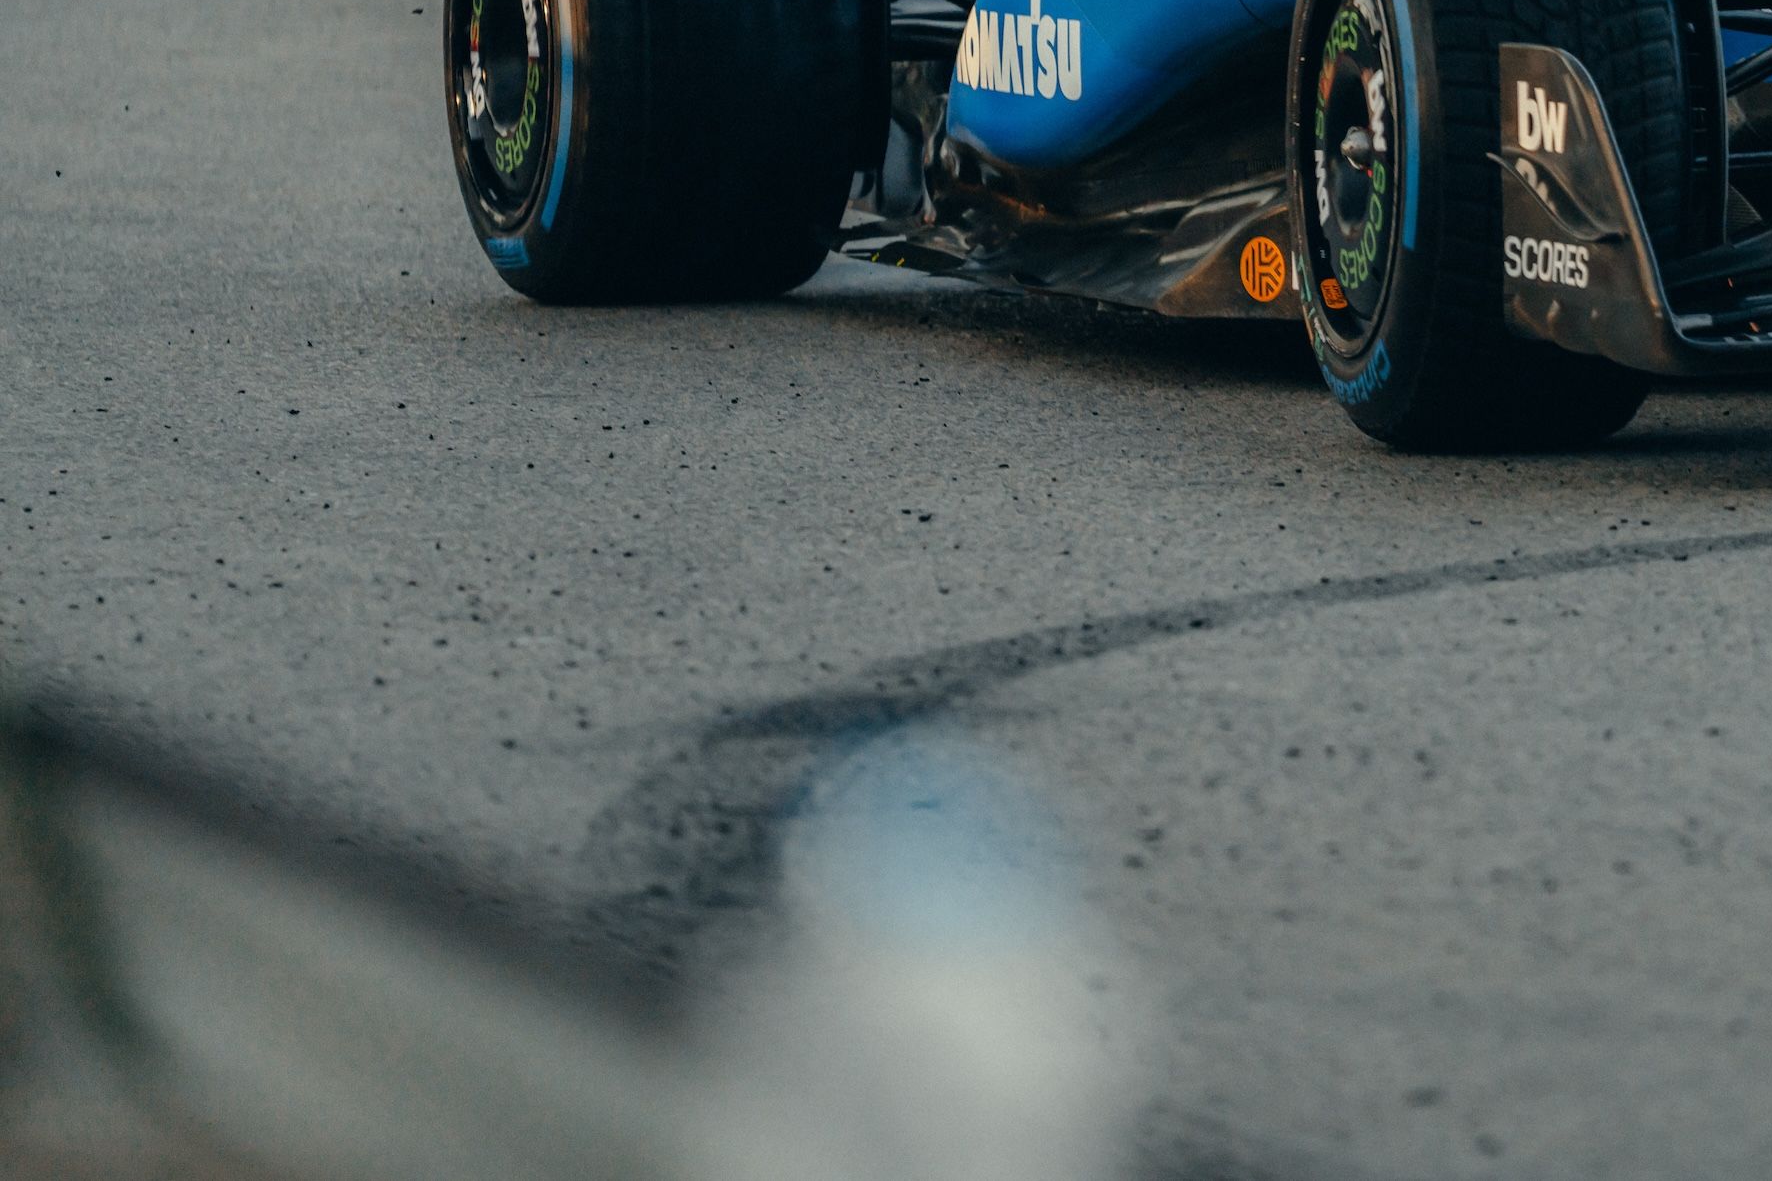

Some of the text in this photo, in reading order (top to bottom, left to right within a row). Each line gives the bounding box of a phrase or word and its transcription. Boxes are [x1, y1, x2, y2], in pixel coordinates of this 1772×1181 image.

[496, 61, 540, 174] SCORES
[1340, 159, 1386, 290] SCORES
[1504, 234, 1590, 289] SCORES
